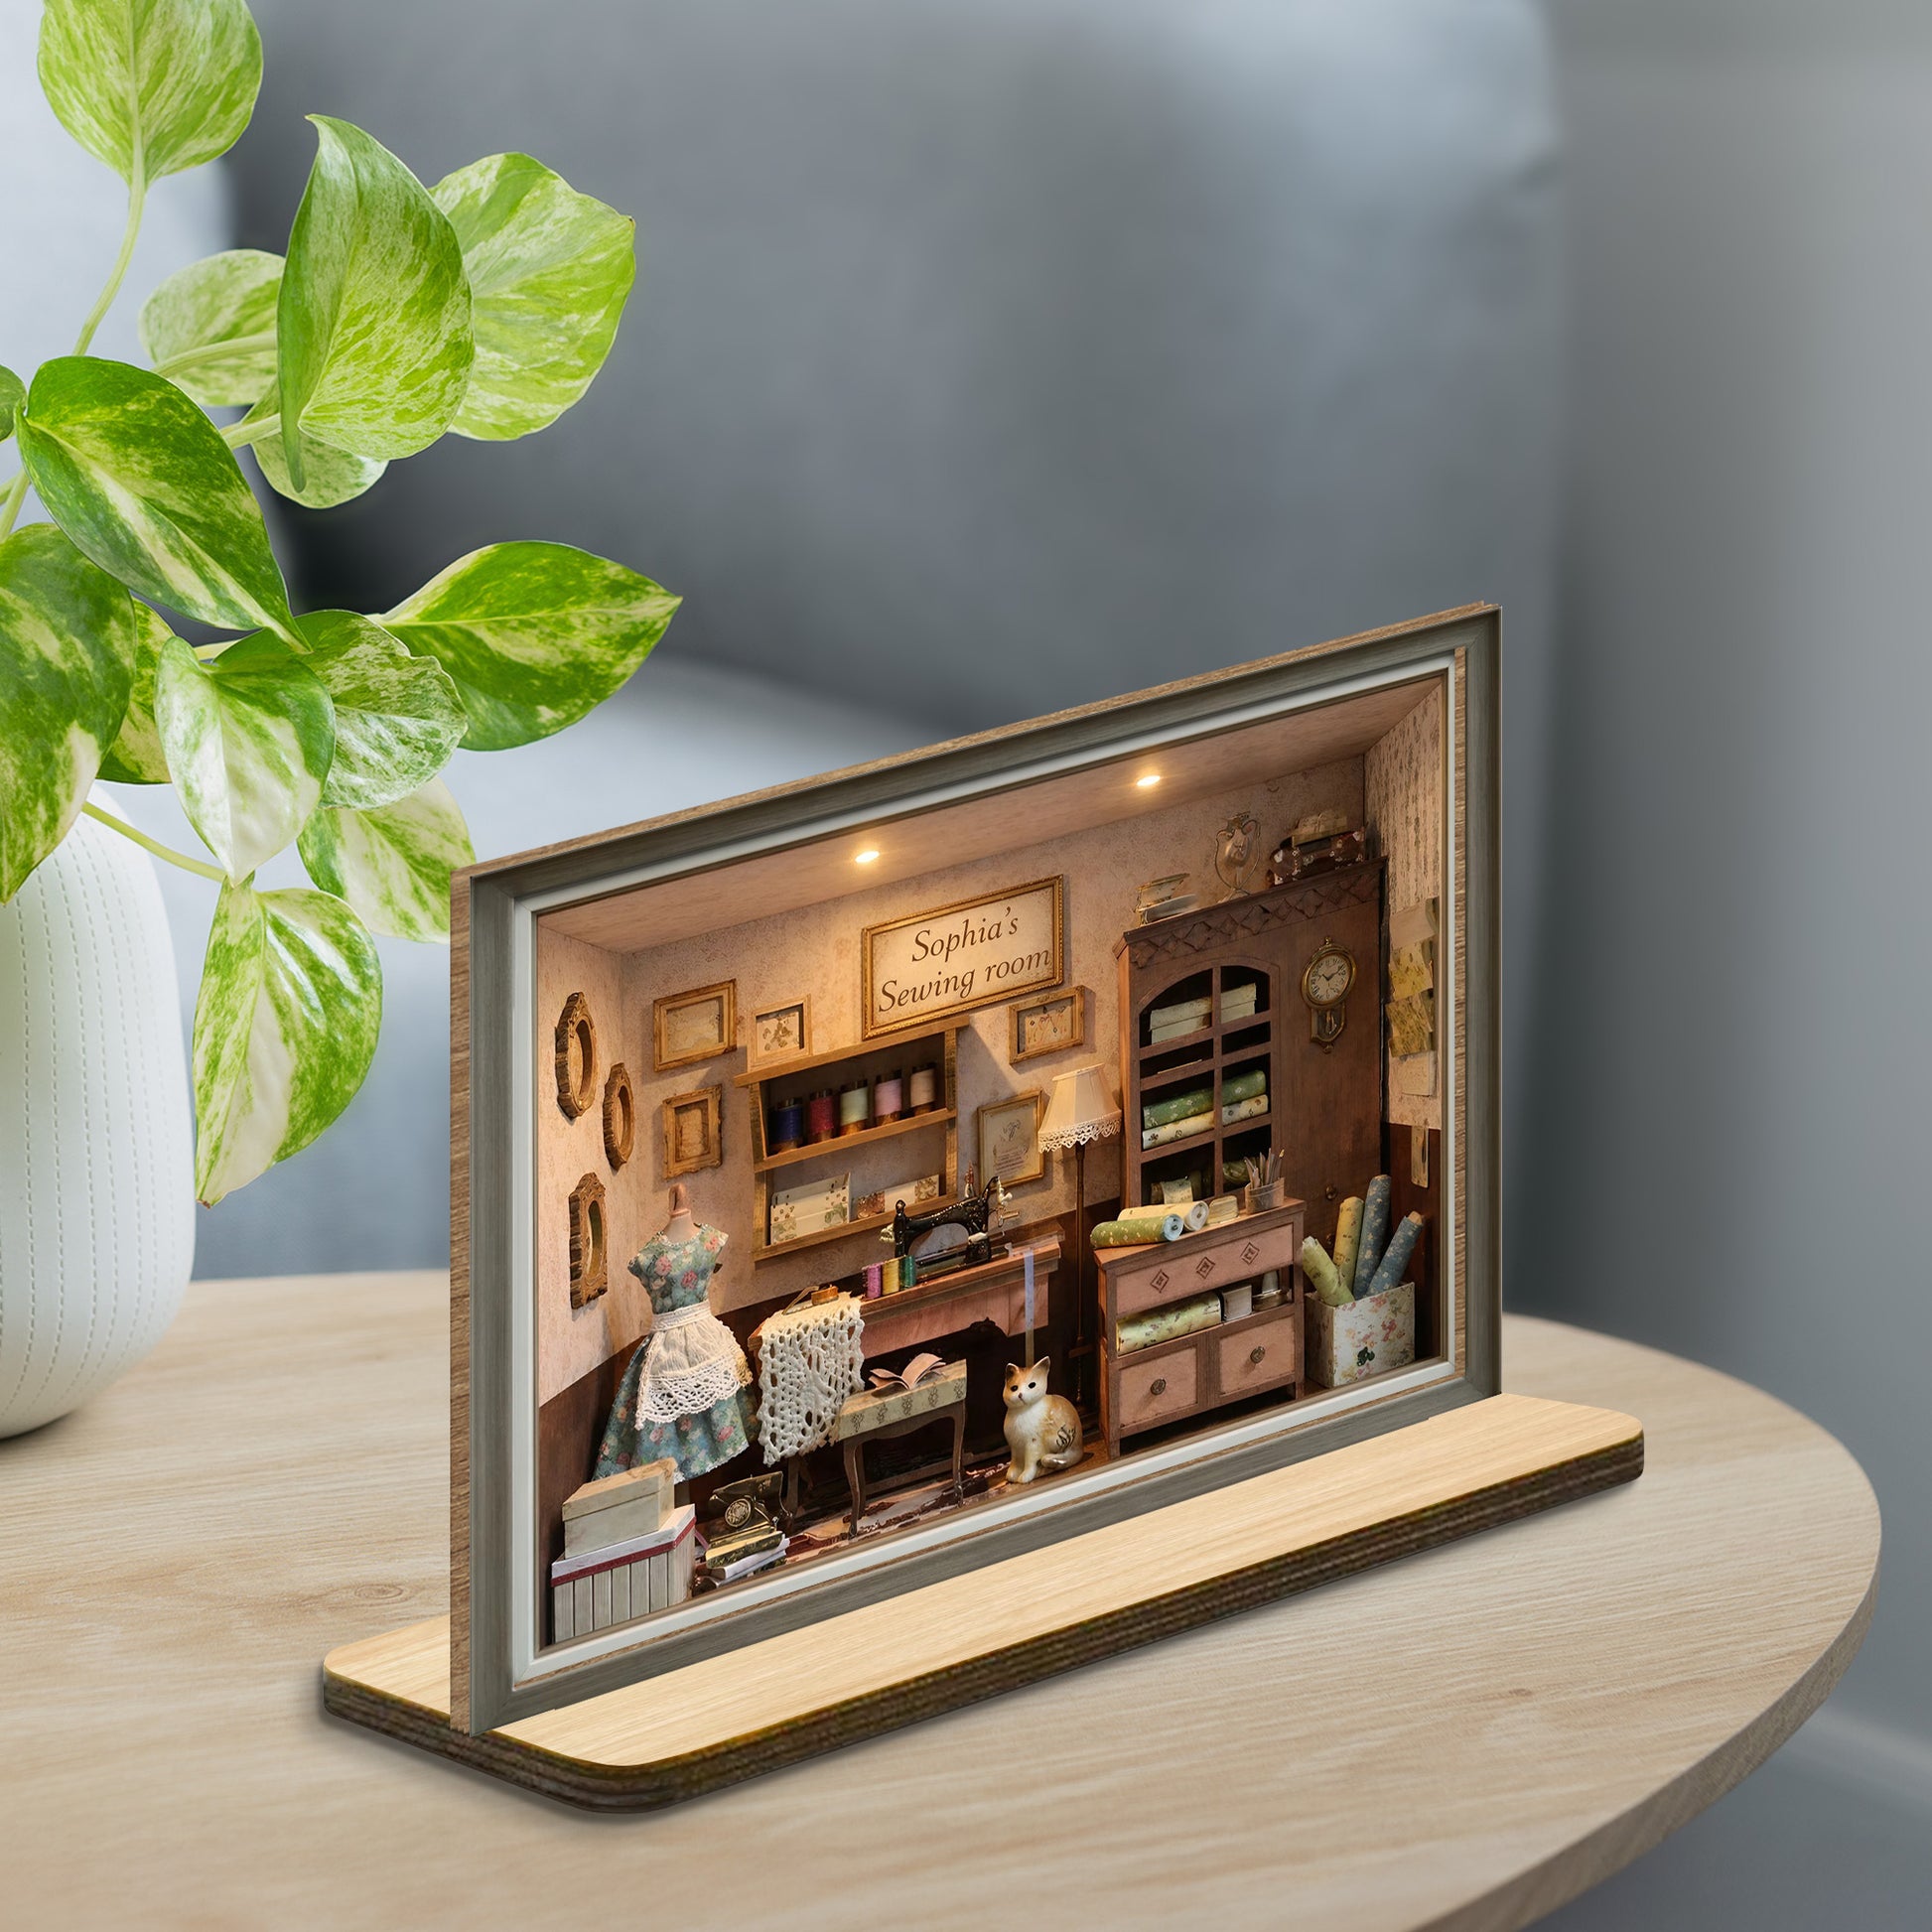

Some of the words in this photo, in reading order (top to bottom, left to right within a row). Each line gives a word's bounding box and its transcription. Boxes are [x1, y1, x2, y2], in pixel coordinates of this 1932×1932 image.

[911, 905, 1019, 963] Sophia's
[878, 969, 976, 1013] Sewing
[985, 949, 1050, 982] room
